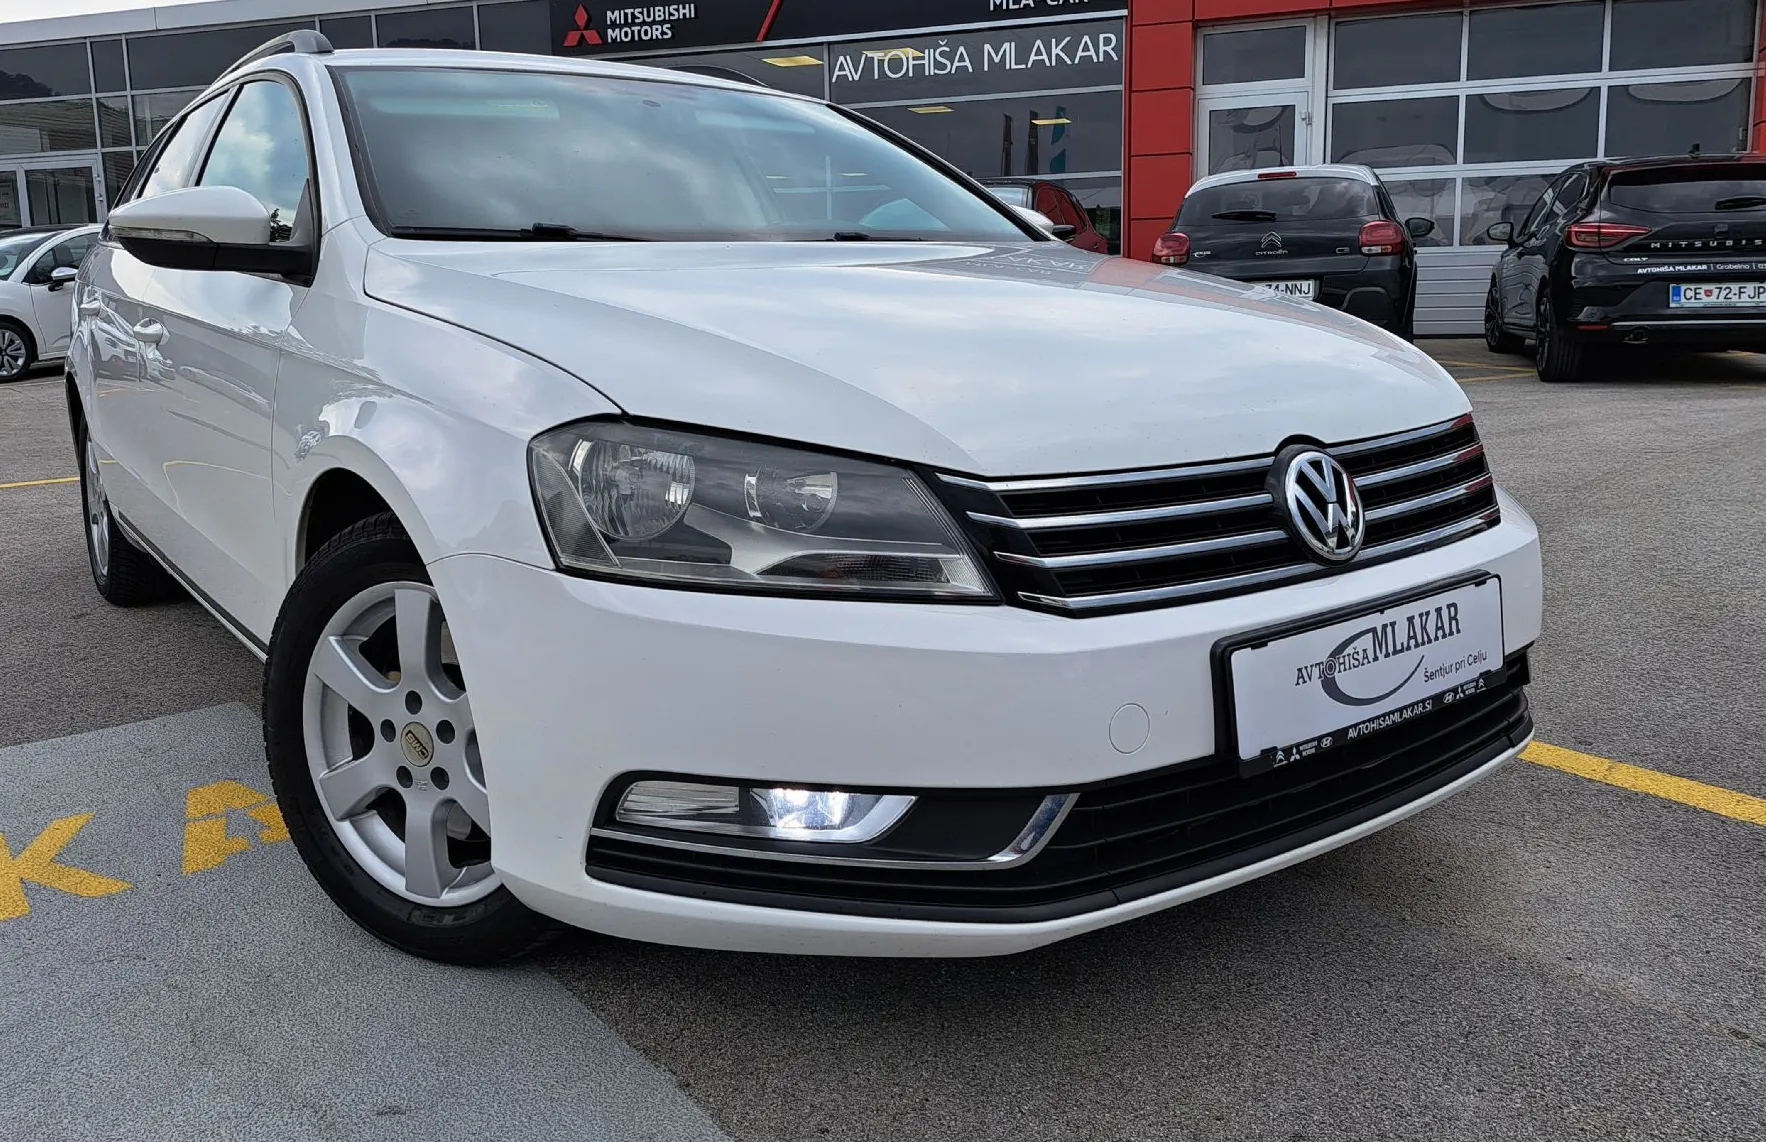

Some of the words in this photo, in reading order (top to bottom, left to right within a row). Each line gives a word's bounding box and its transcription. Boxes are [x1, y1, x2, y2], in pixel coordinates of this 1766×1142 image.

[606, 3, 695, 25] MITSUBISHI
[607, 23, 672, 43] MOTORS
[832, 39, 973, 83] AVTOHIŠA
[983, 33, 1119, 71] MLAKAR
[1637, 264, 1674, 275] AVTOHIŠA
[1675, 264, 1708, 272] MLAKAR
[1683, 287, 1703, 302] CE
[1714, 285, 1766, 300] 72-FJP
[1371, 602, 1462, 663] MLAKAR
[1424, 663, 1455, 683] Šentjur
[1455, 657, 1466, 674] pri
[1466, 650, 1488, 667] Celju
[1347, 699, 1433, 740] AVTOHISAMLAKAR.SI
